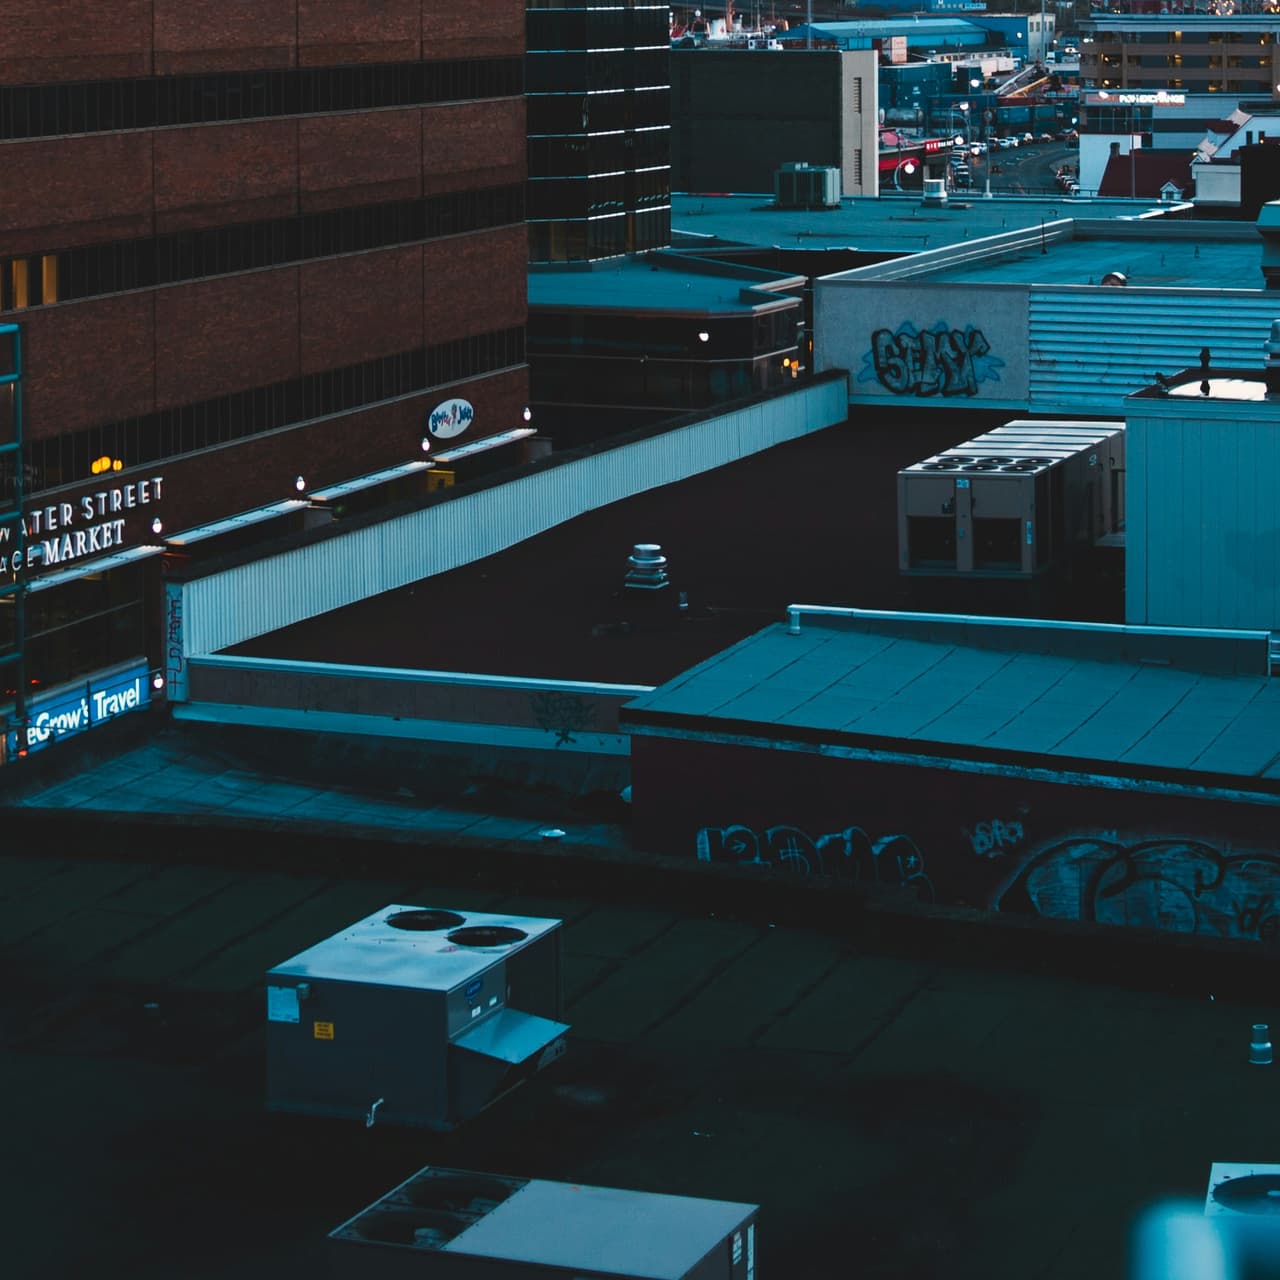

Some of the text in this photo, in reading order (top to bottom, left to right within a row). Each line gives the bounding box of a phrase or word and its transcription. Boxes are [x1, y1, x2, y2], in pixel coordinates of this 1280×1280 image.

[81, 477, 163, 520] STREET
[40, 519, 125, 566] MARKET
[16, 677, 140, 746] eGrow's Travel
